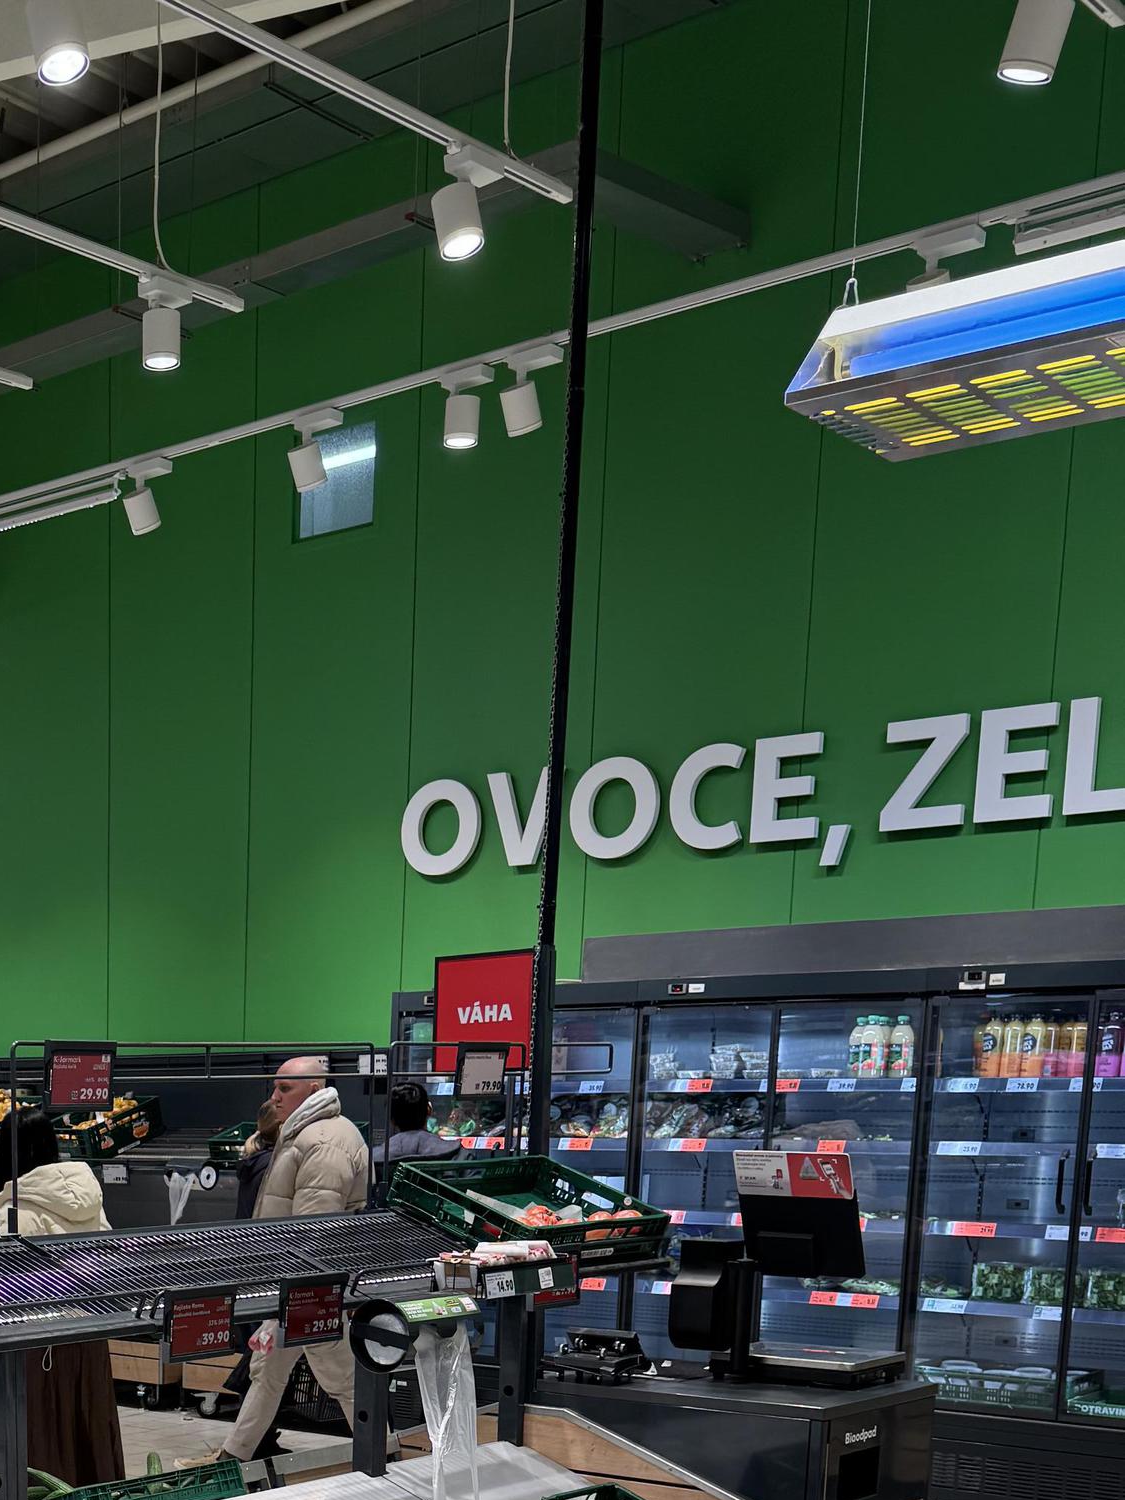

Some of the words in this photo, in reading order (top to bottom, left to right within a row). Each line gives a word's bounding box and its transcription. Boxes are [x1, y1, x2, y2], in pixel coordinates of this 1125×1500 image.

[401, 732, 851, 875] OVOCE,
[879, 697, 1125, 831] ZEL
[457, 1000, 513, 1025] VÁHA
[80, 1087, 109, 1100] 29.90
[481, 1081, 502, 1091] 79.90
[496, 1279, 514, 1293] 14.90
[312, 1317, 340, 1333] 29.90
[201, 1330, 230, 1345] 39.90
